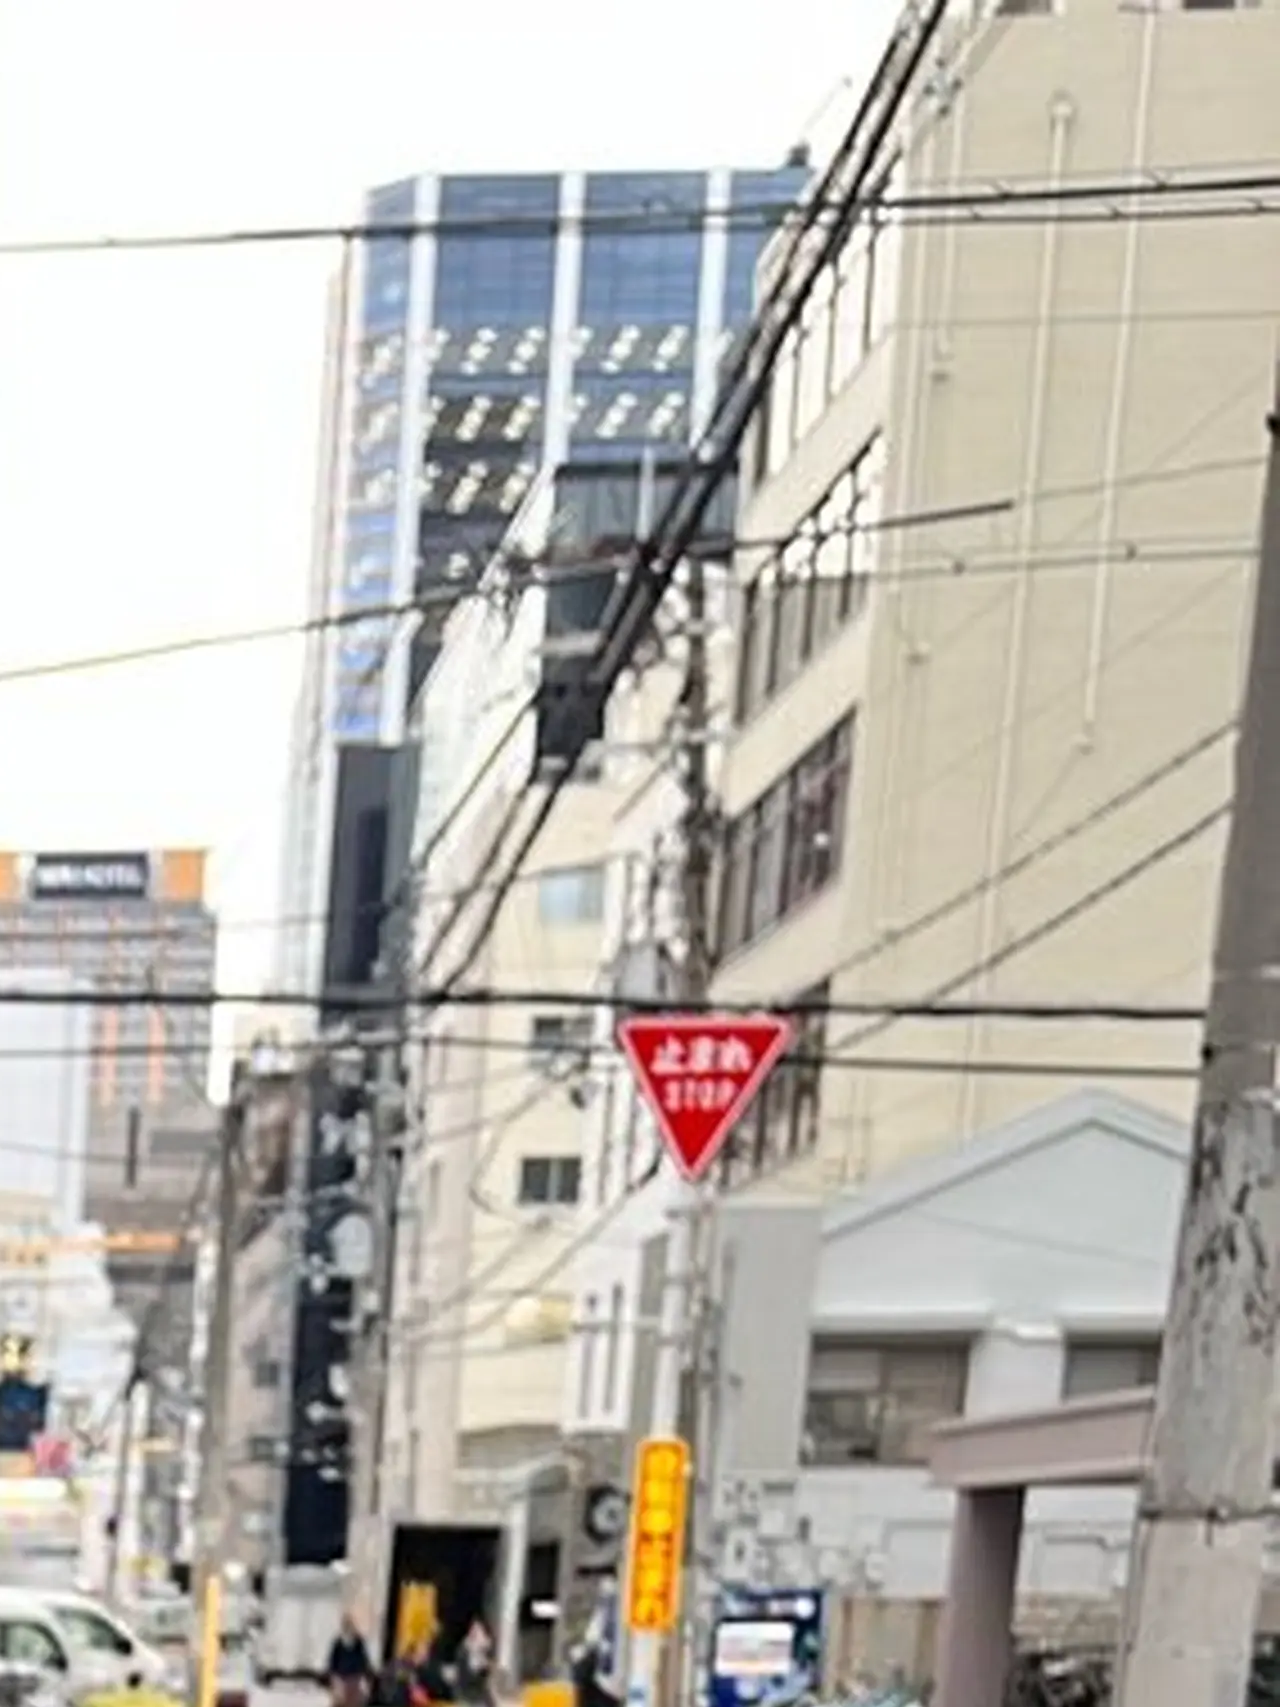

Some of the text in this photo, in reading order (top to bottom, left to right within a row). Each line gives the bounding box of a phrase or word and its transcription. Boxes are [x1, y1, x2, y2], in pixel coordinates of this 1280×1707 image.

[649, 1033, 754, 1076] 止まれ
[663, 1077, 737, 1112] STOP
